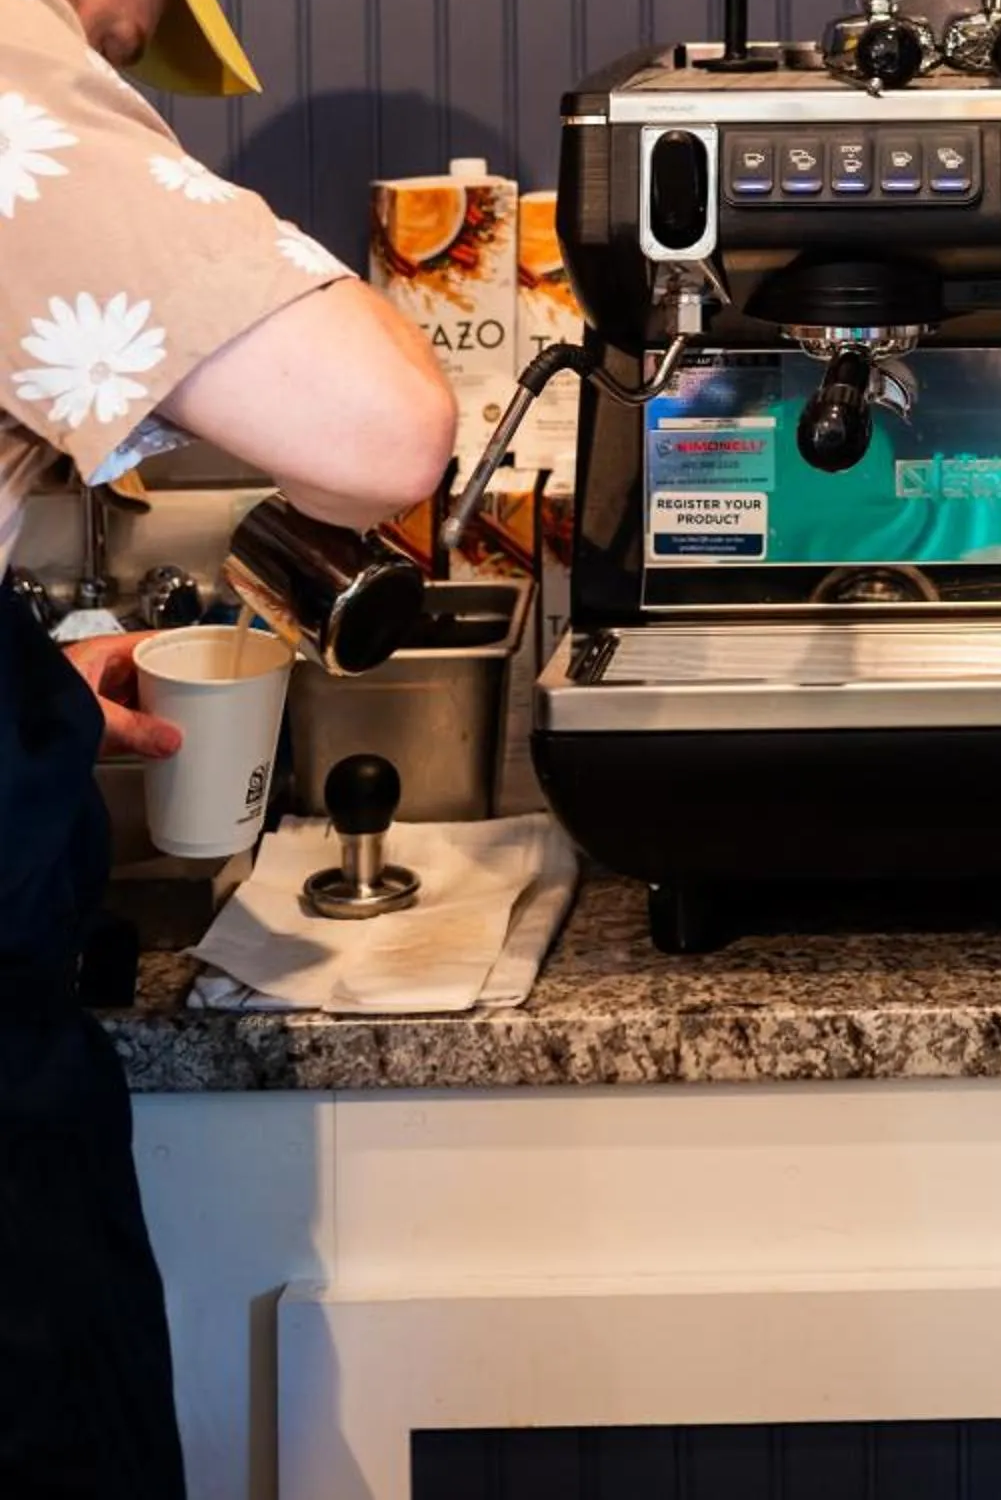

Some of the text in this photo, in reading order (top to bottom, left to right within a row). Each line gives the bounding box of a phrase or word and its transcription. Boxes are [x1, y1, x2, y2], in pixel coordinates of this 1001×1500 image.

[420, 319, 505, 350] AZO
[657, 499, 761, 510] REGISTER YOUR
[677, 514, 740, 526] PRODUCT
